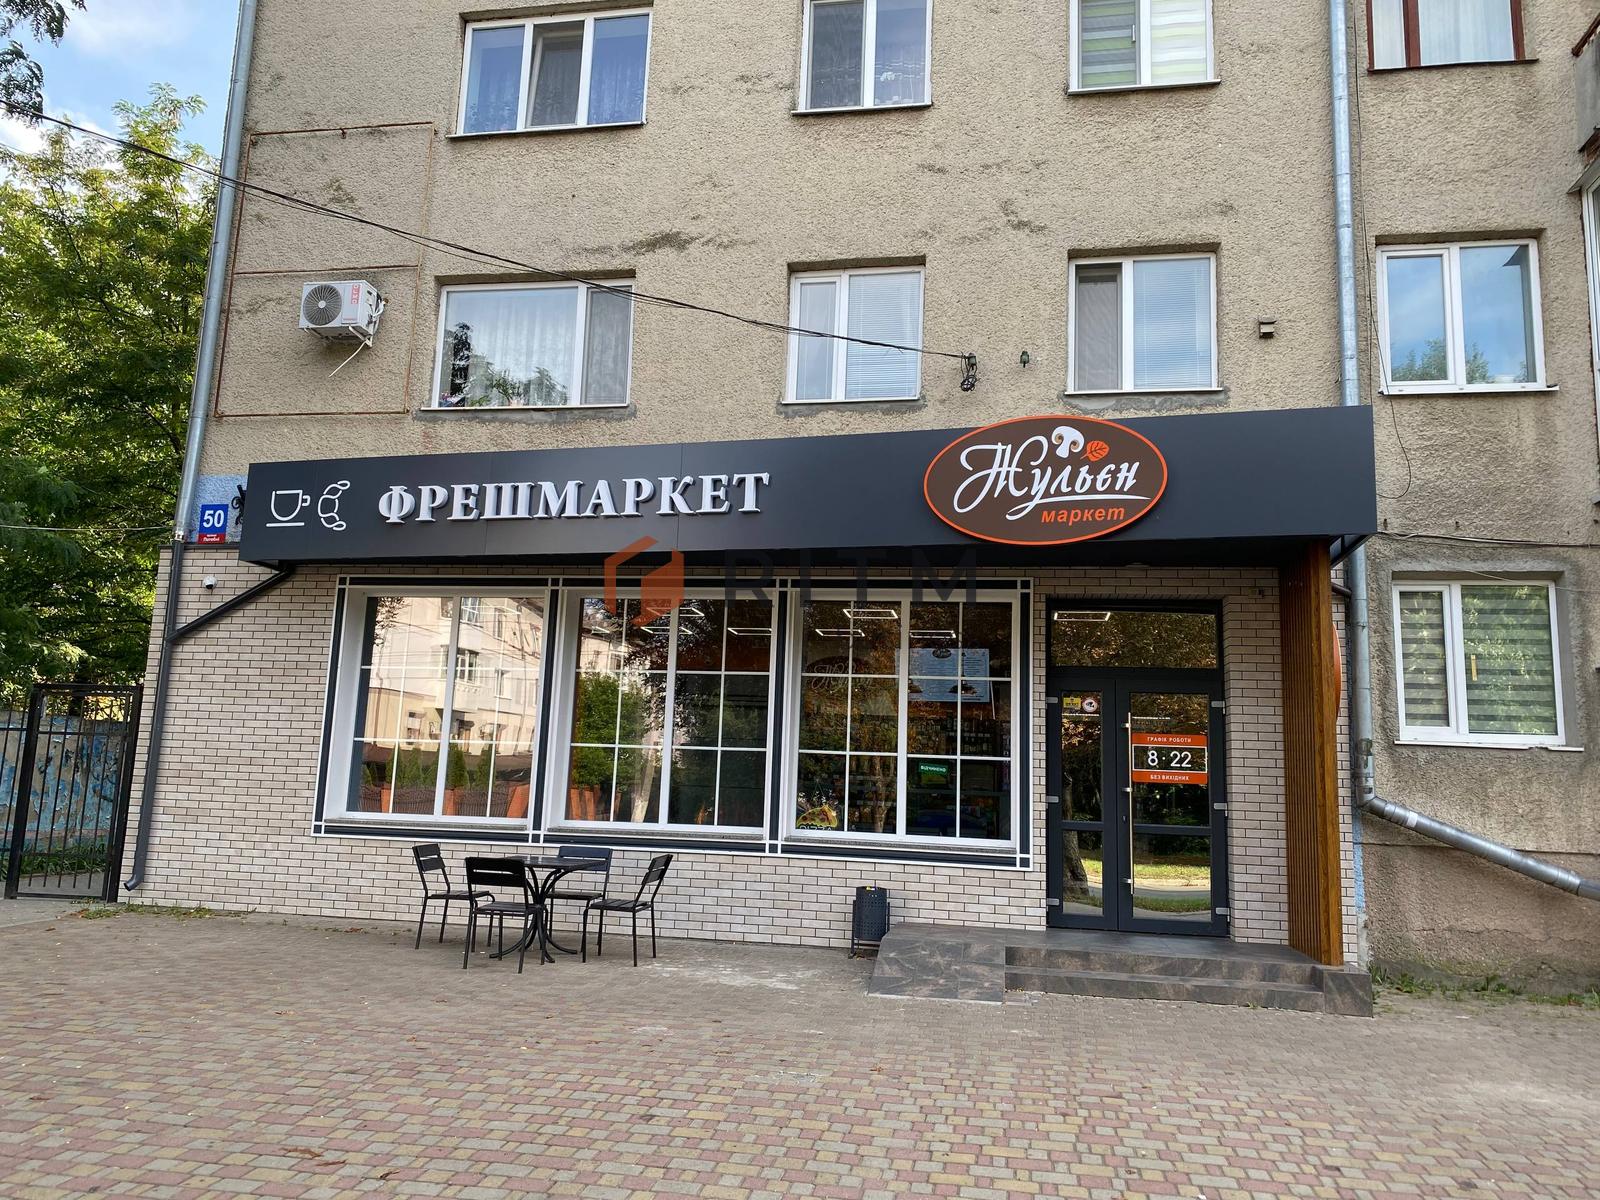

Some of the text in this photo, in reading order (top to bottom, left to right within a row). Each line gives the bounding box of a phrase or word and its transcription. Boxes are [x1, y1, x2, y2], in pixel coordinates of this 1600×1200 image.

[378, 472, 770, 524] ФРЕШМАРКЕТ
[202, 509, 225, 528] 50
[1041, 506, 1125, 526] маркет
